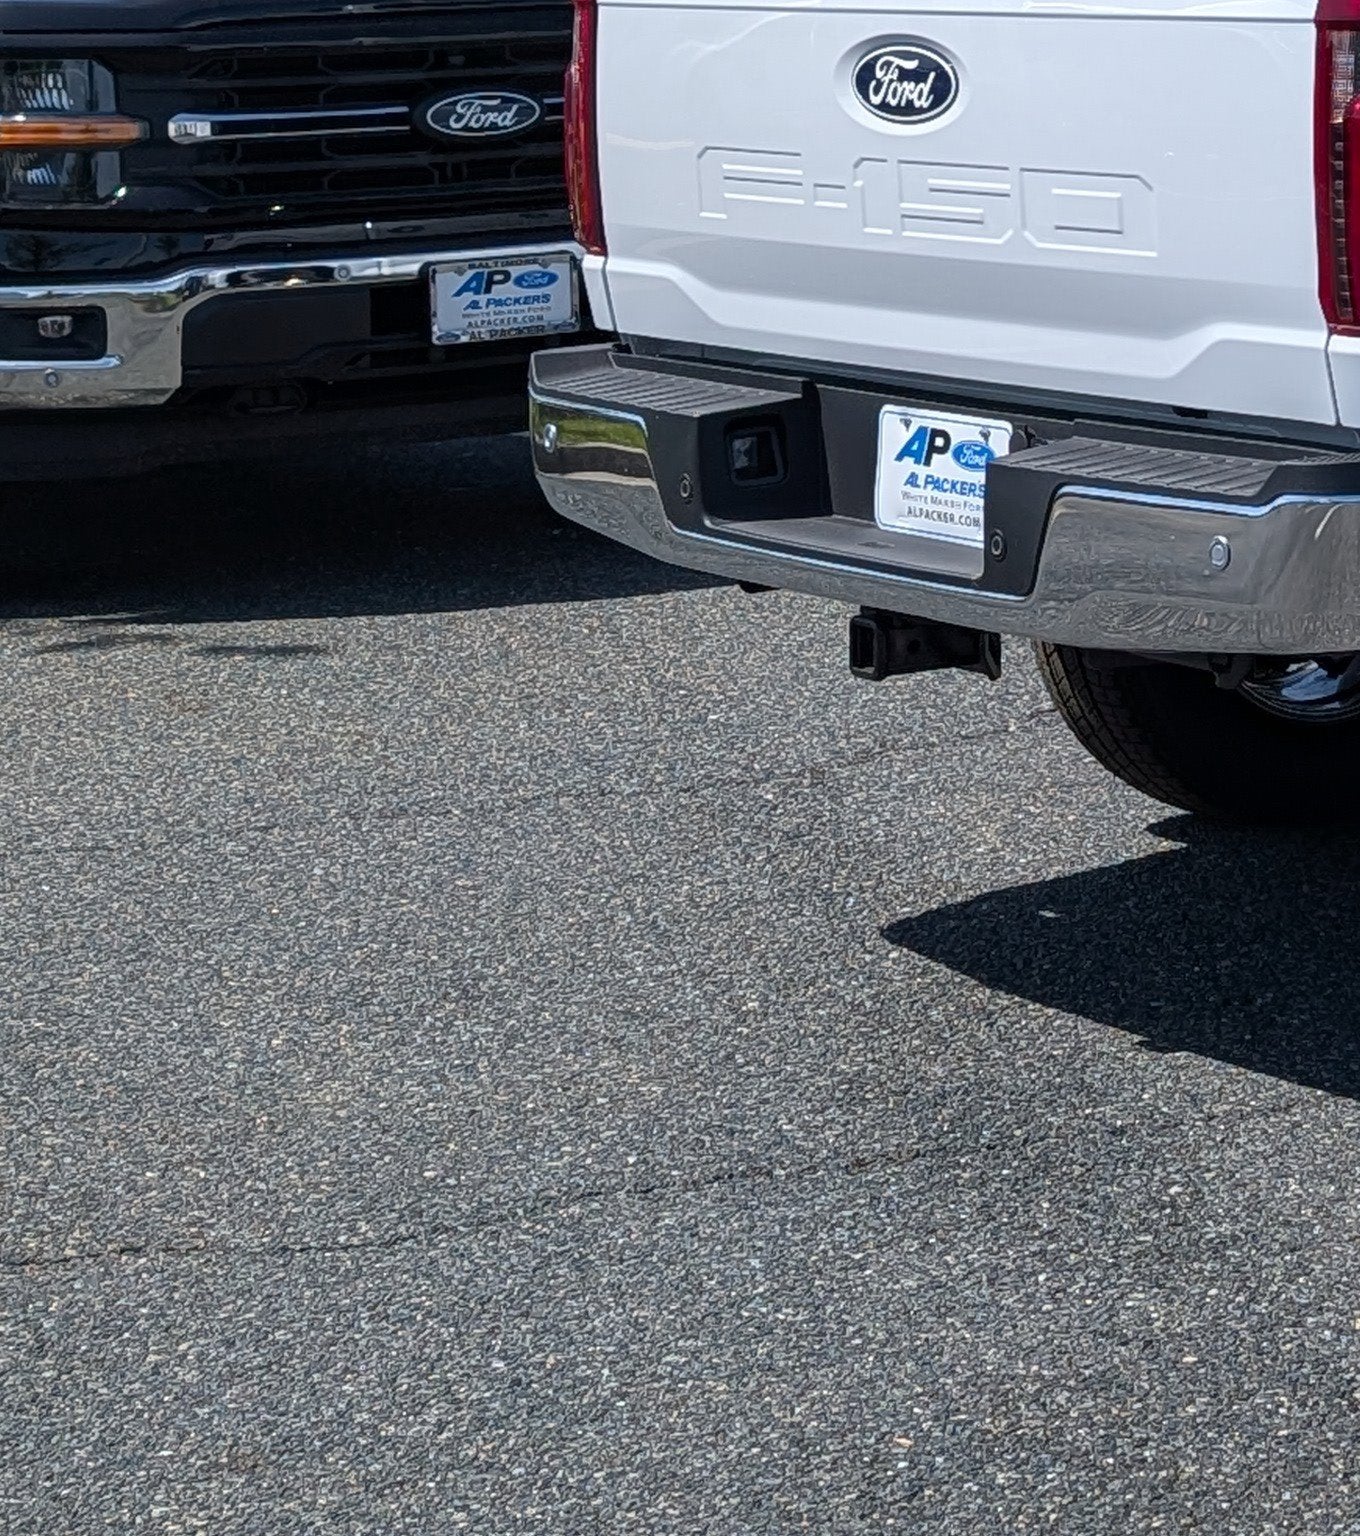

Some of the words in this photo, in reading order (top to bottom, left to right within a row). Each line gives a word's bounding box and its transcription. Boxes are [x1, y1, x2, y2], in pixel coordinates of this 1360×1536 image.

[868, 55, 937, 109] Ford
[449, 98, 520, 129] Ford
[698, 146, 1157, 257] F-150
[452, 269, 512, 298] AP
[894, 425, 952, 468] AP
[960, 444, 988, 466] Ford
[903, 471, 921, 488] AL
